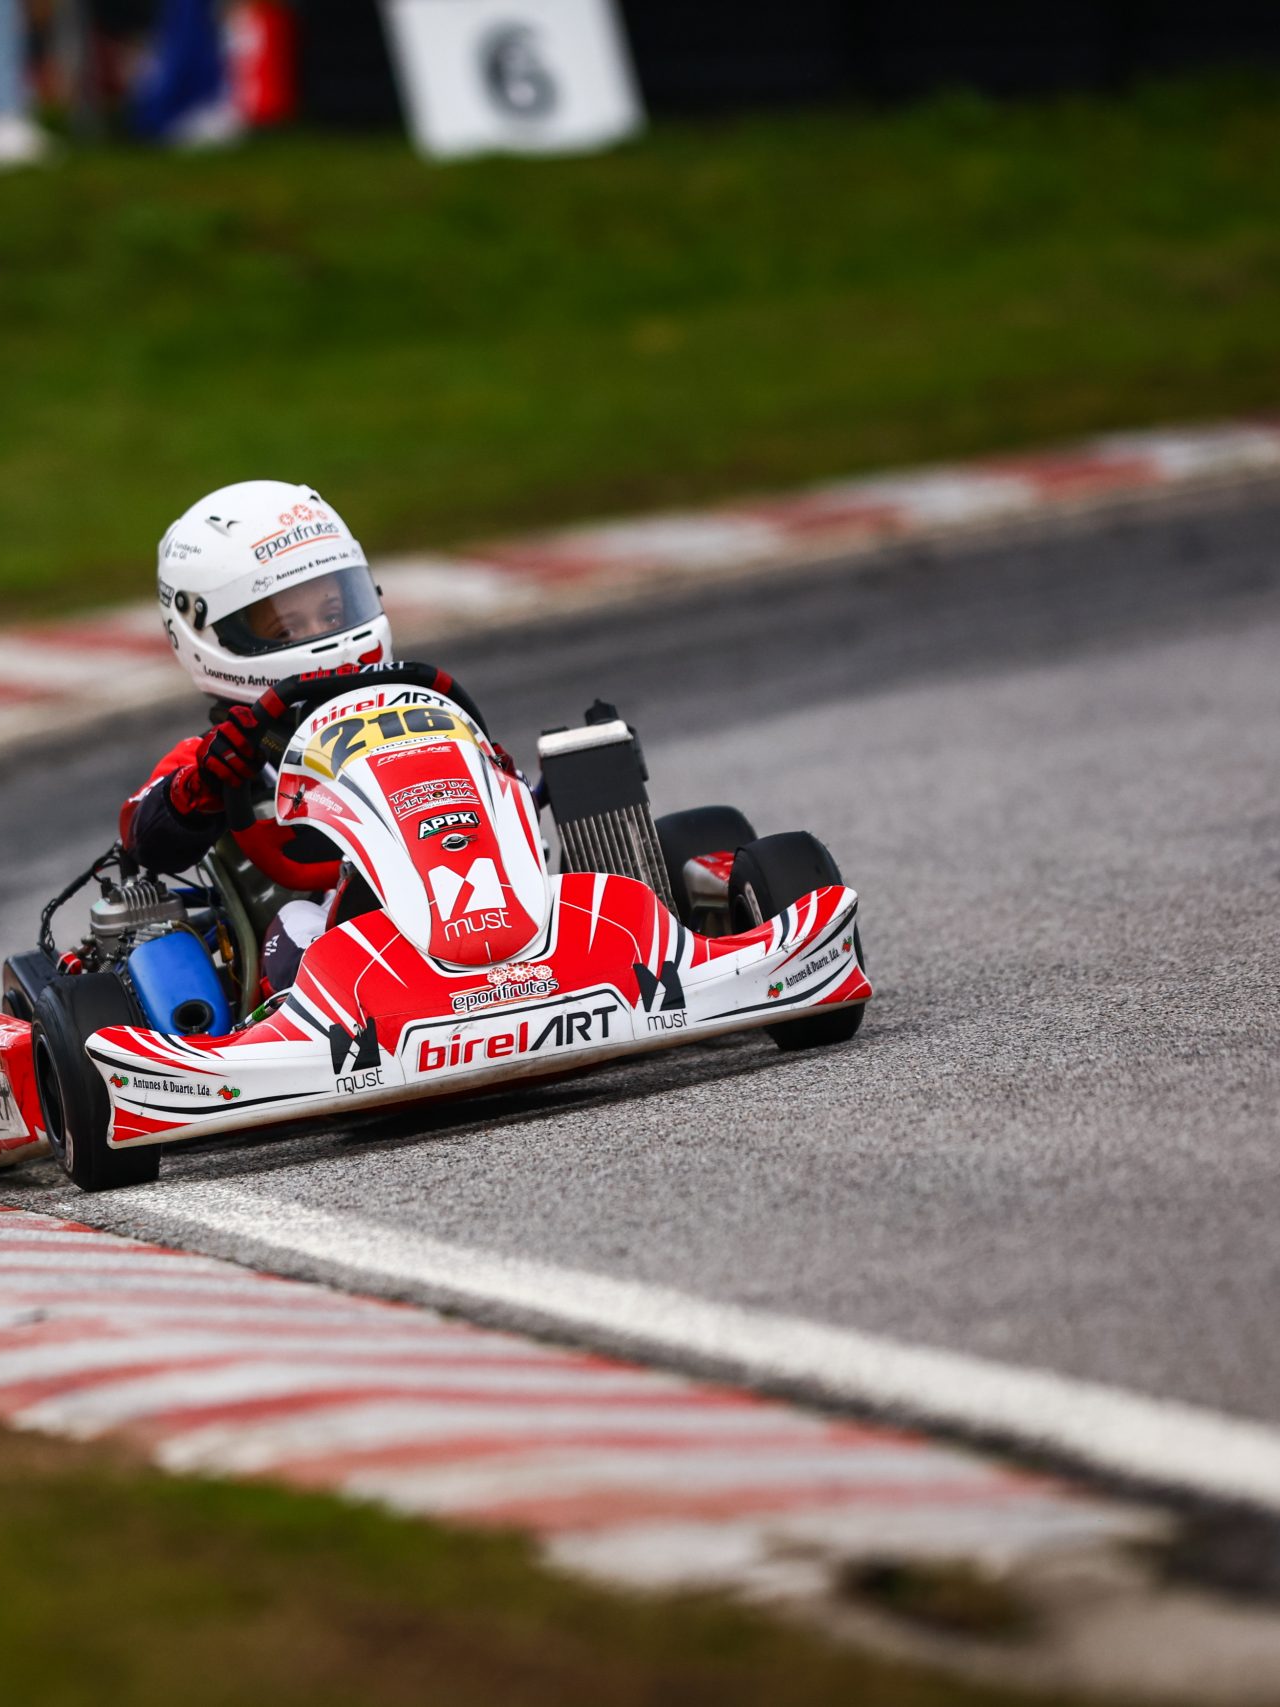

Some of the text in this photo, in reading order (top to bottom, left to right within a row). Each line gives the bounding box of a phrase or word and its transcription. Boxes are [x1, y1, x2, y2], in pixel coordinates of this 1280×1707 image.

[475, 19, 557, 119] 6
[254, 521, 340, 560] eporifrutas
[276, 565, 308, 581] Antunes
[203, 665, 246, 685] Lourenço
[311, 691, 453, 735] birelART
[320, 707, 456, 776] 216
[376, 736, 439, 752] RAVENOL
[377, 746, 453, 765] FREELINE
[391, 780, 474, 804] TACHO DA
[419, 812, 477, 838] APPK
[444, 909, 512, 941] must
[785, 969, 807, 988] Antunes
[453, 978, 559, 1011] eporifrutas
[647, 1008, 688, 1030] must
[417, 1004, 618, 1073] birelART
[133, 1076, 161, 1090] Antunes
[162, 1080, 169, 1091] &
[336, 1068, 385, 1094] must
